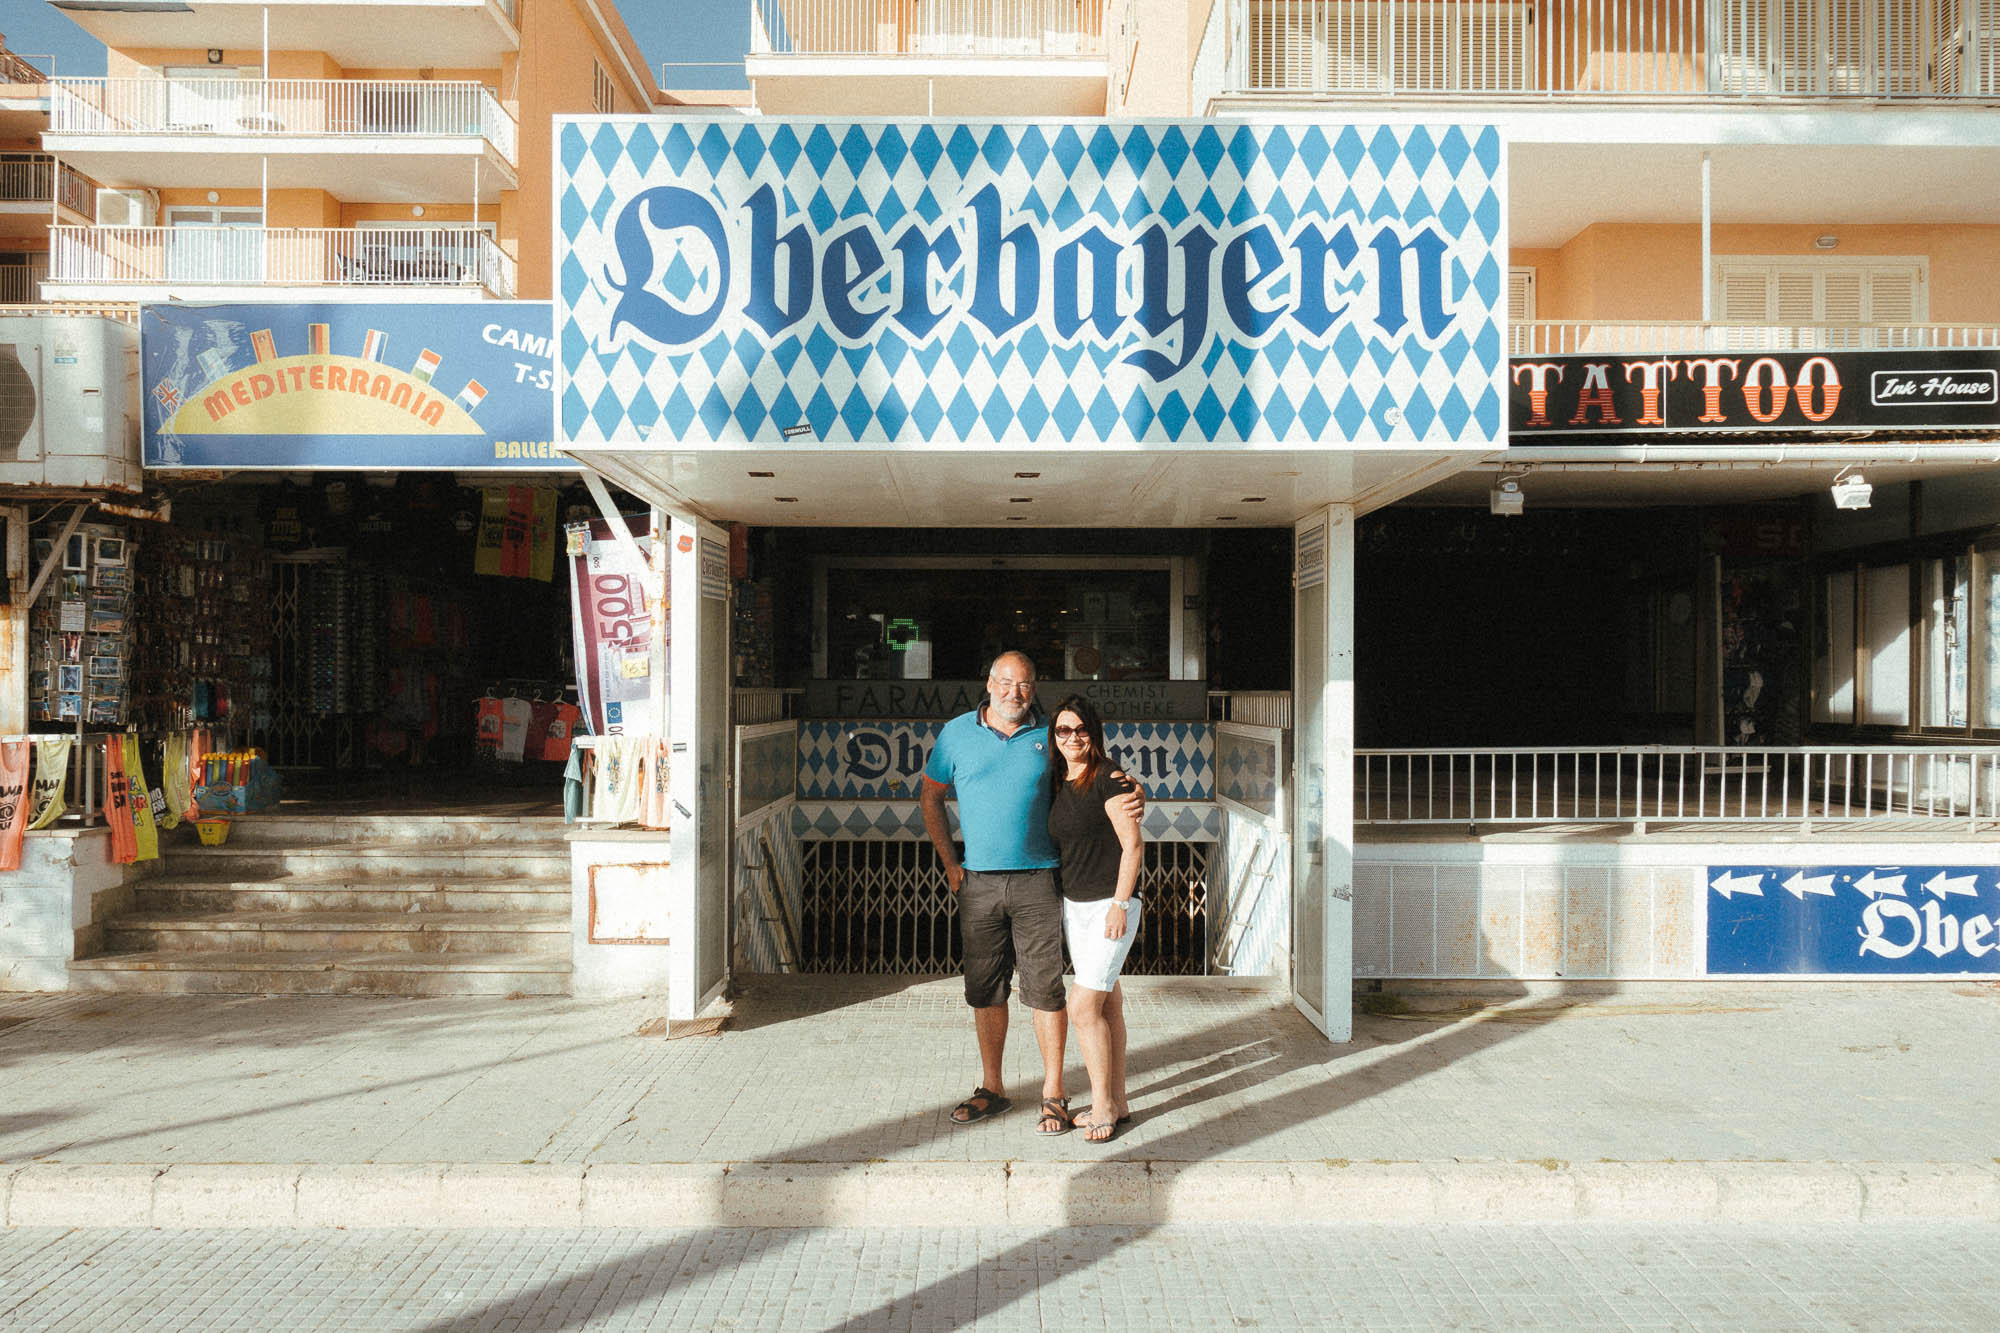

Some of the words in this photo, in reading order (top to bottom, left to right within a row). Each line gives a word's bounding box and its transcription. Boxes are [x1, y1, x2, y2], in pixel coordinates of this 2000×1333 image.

[603, 181, 1457, 383] Oberbayern
[203, 365, 445, 427] MEDITERRANIA
[513, 362, 554, 393] T-S
[1511, 356, 1842, 425] TATTOO
[1877, 377, 1917, 399] Ink
[1920, 376, 1991, 397] House
[595, 574, 633, 645] 500
[1086, 684, 1168, 698] CHEMIST
[1093, 701, 1176, 714] POTHEKE
[1857, 899, 2000, 959] Obe
